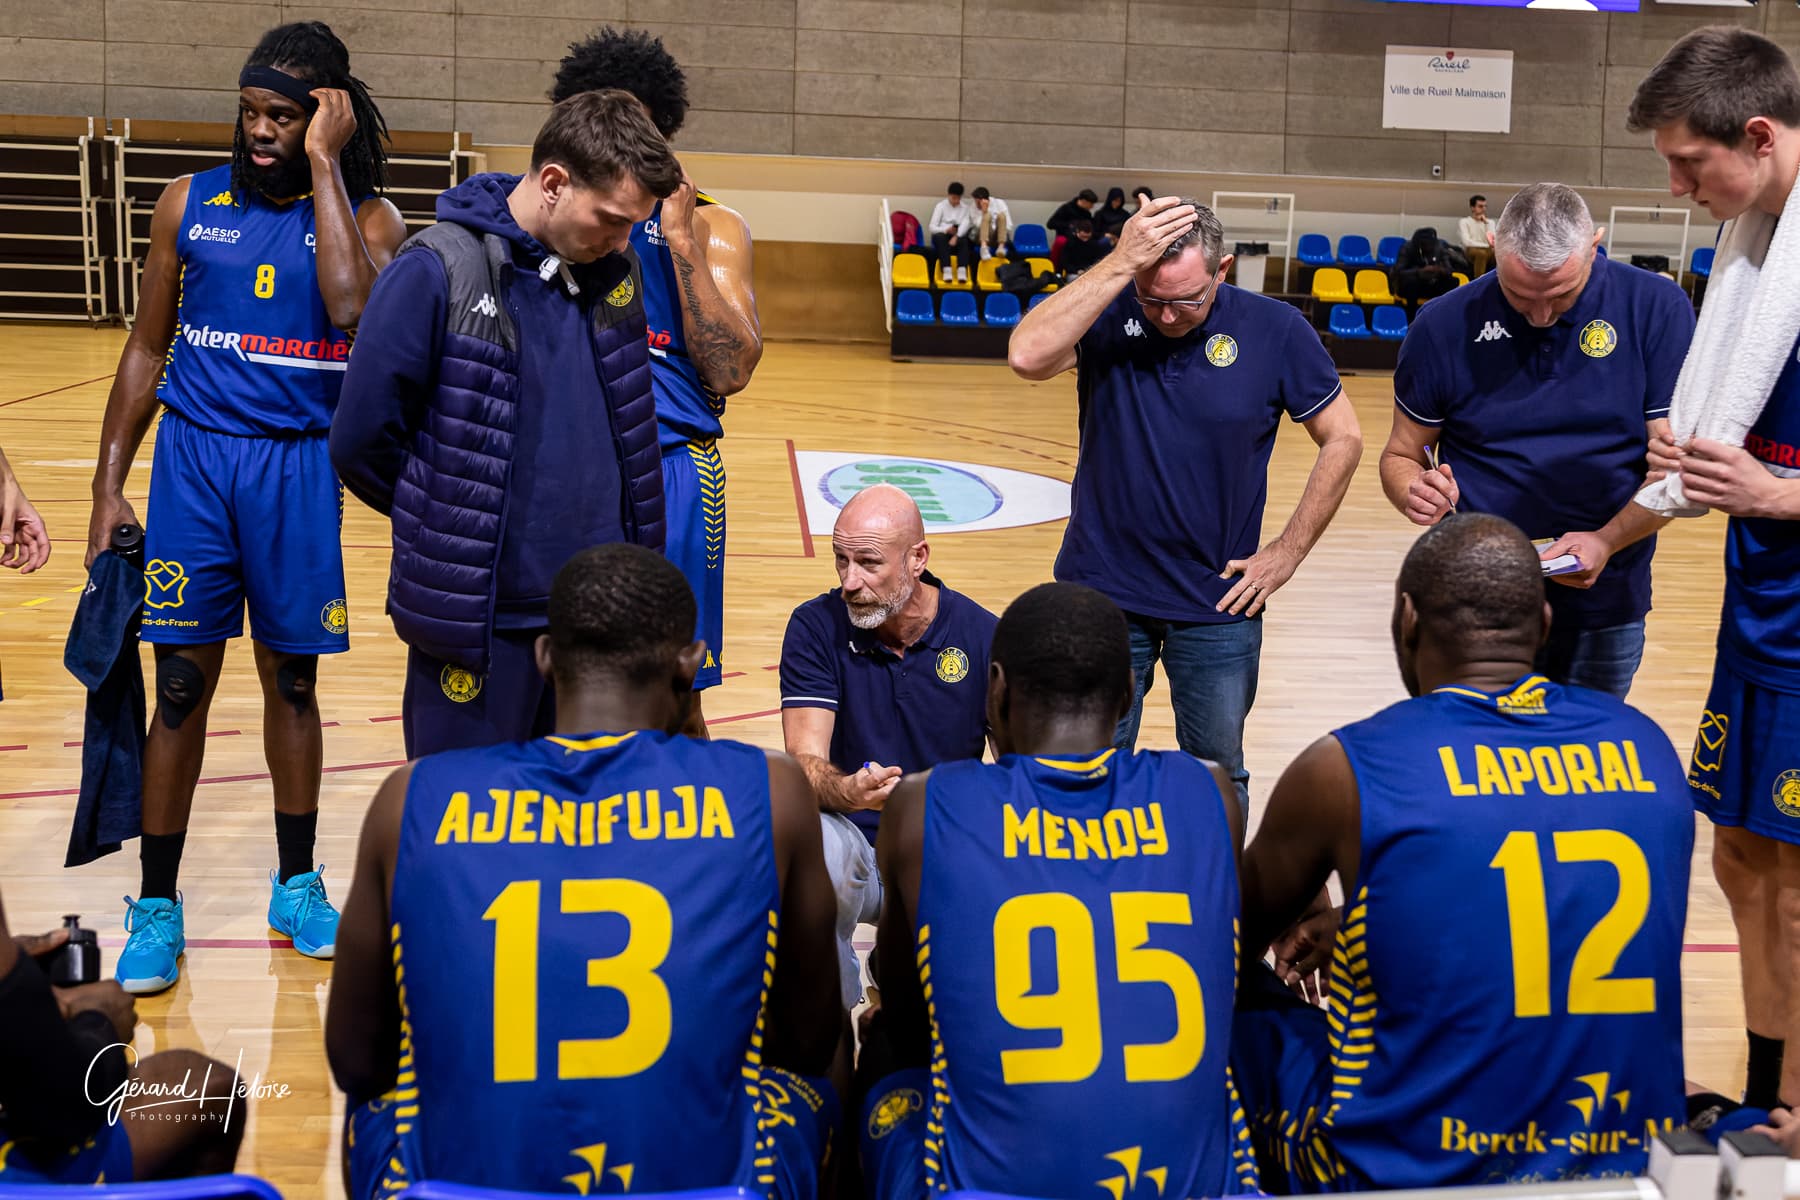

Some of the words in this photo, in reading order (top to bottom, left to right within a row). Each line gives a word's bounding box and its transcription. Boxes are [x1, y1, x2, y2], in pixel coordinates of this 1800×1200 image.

[1428, 56, 1471, 70] Rueil
[1390, 85, 1410, 95] Ville
[1413, 85, 1425, 96] de
[1428, 86, 1453, 96] Rueil
[1455, 87, 1506, 99] Malmaison
[200, 236, 237, 245] MUTUELLE
[254, 264, 276, 299] 8
[1438, 740, 1656, 796] LAPORAL
[435, 785, 735, 846] AJENIFUJA
[1003, 802, 1169, 860] MENDY
[1489, 829, 1656, 1018] 12
[481, 878, 673, 1082] 13
[993, 892, 1206, 1084] 95
